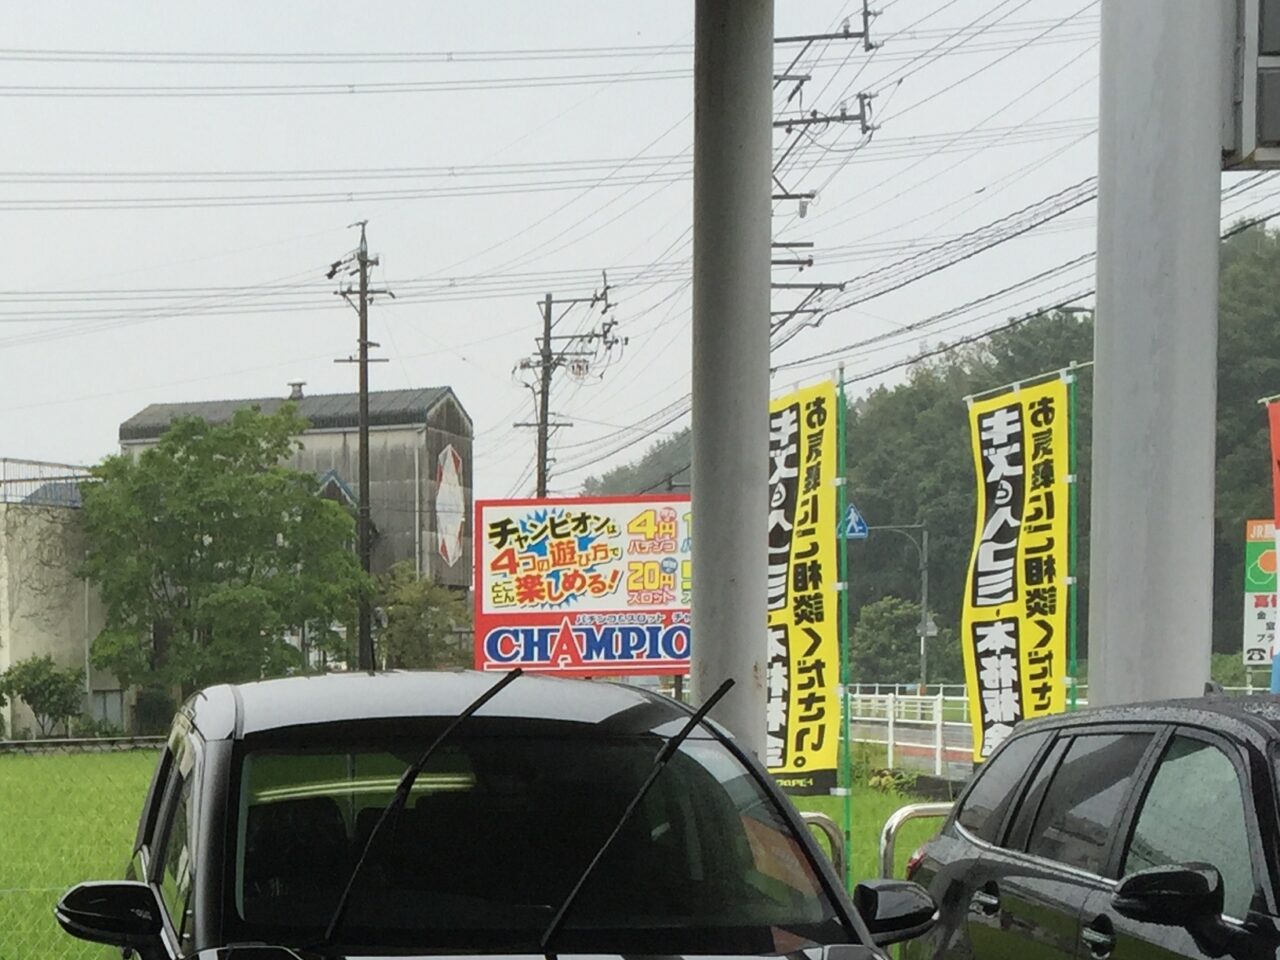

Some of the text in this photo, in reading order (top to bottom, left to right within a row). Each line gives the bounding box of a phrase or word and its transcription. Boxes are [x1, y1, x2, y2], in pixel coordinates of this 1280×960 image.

[488, 510, 617, 549] チャンピオンは
[490, 540, 620, 575] 4コの遊び方で
[628, 540, 677, 554] パチンコ
[515, 570, 620, 604] 楽しめる!
[628, 590, 676, 604] スロット
[485, 618, 691, 667] CHAMPIO
